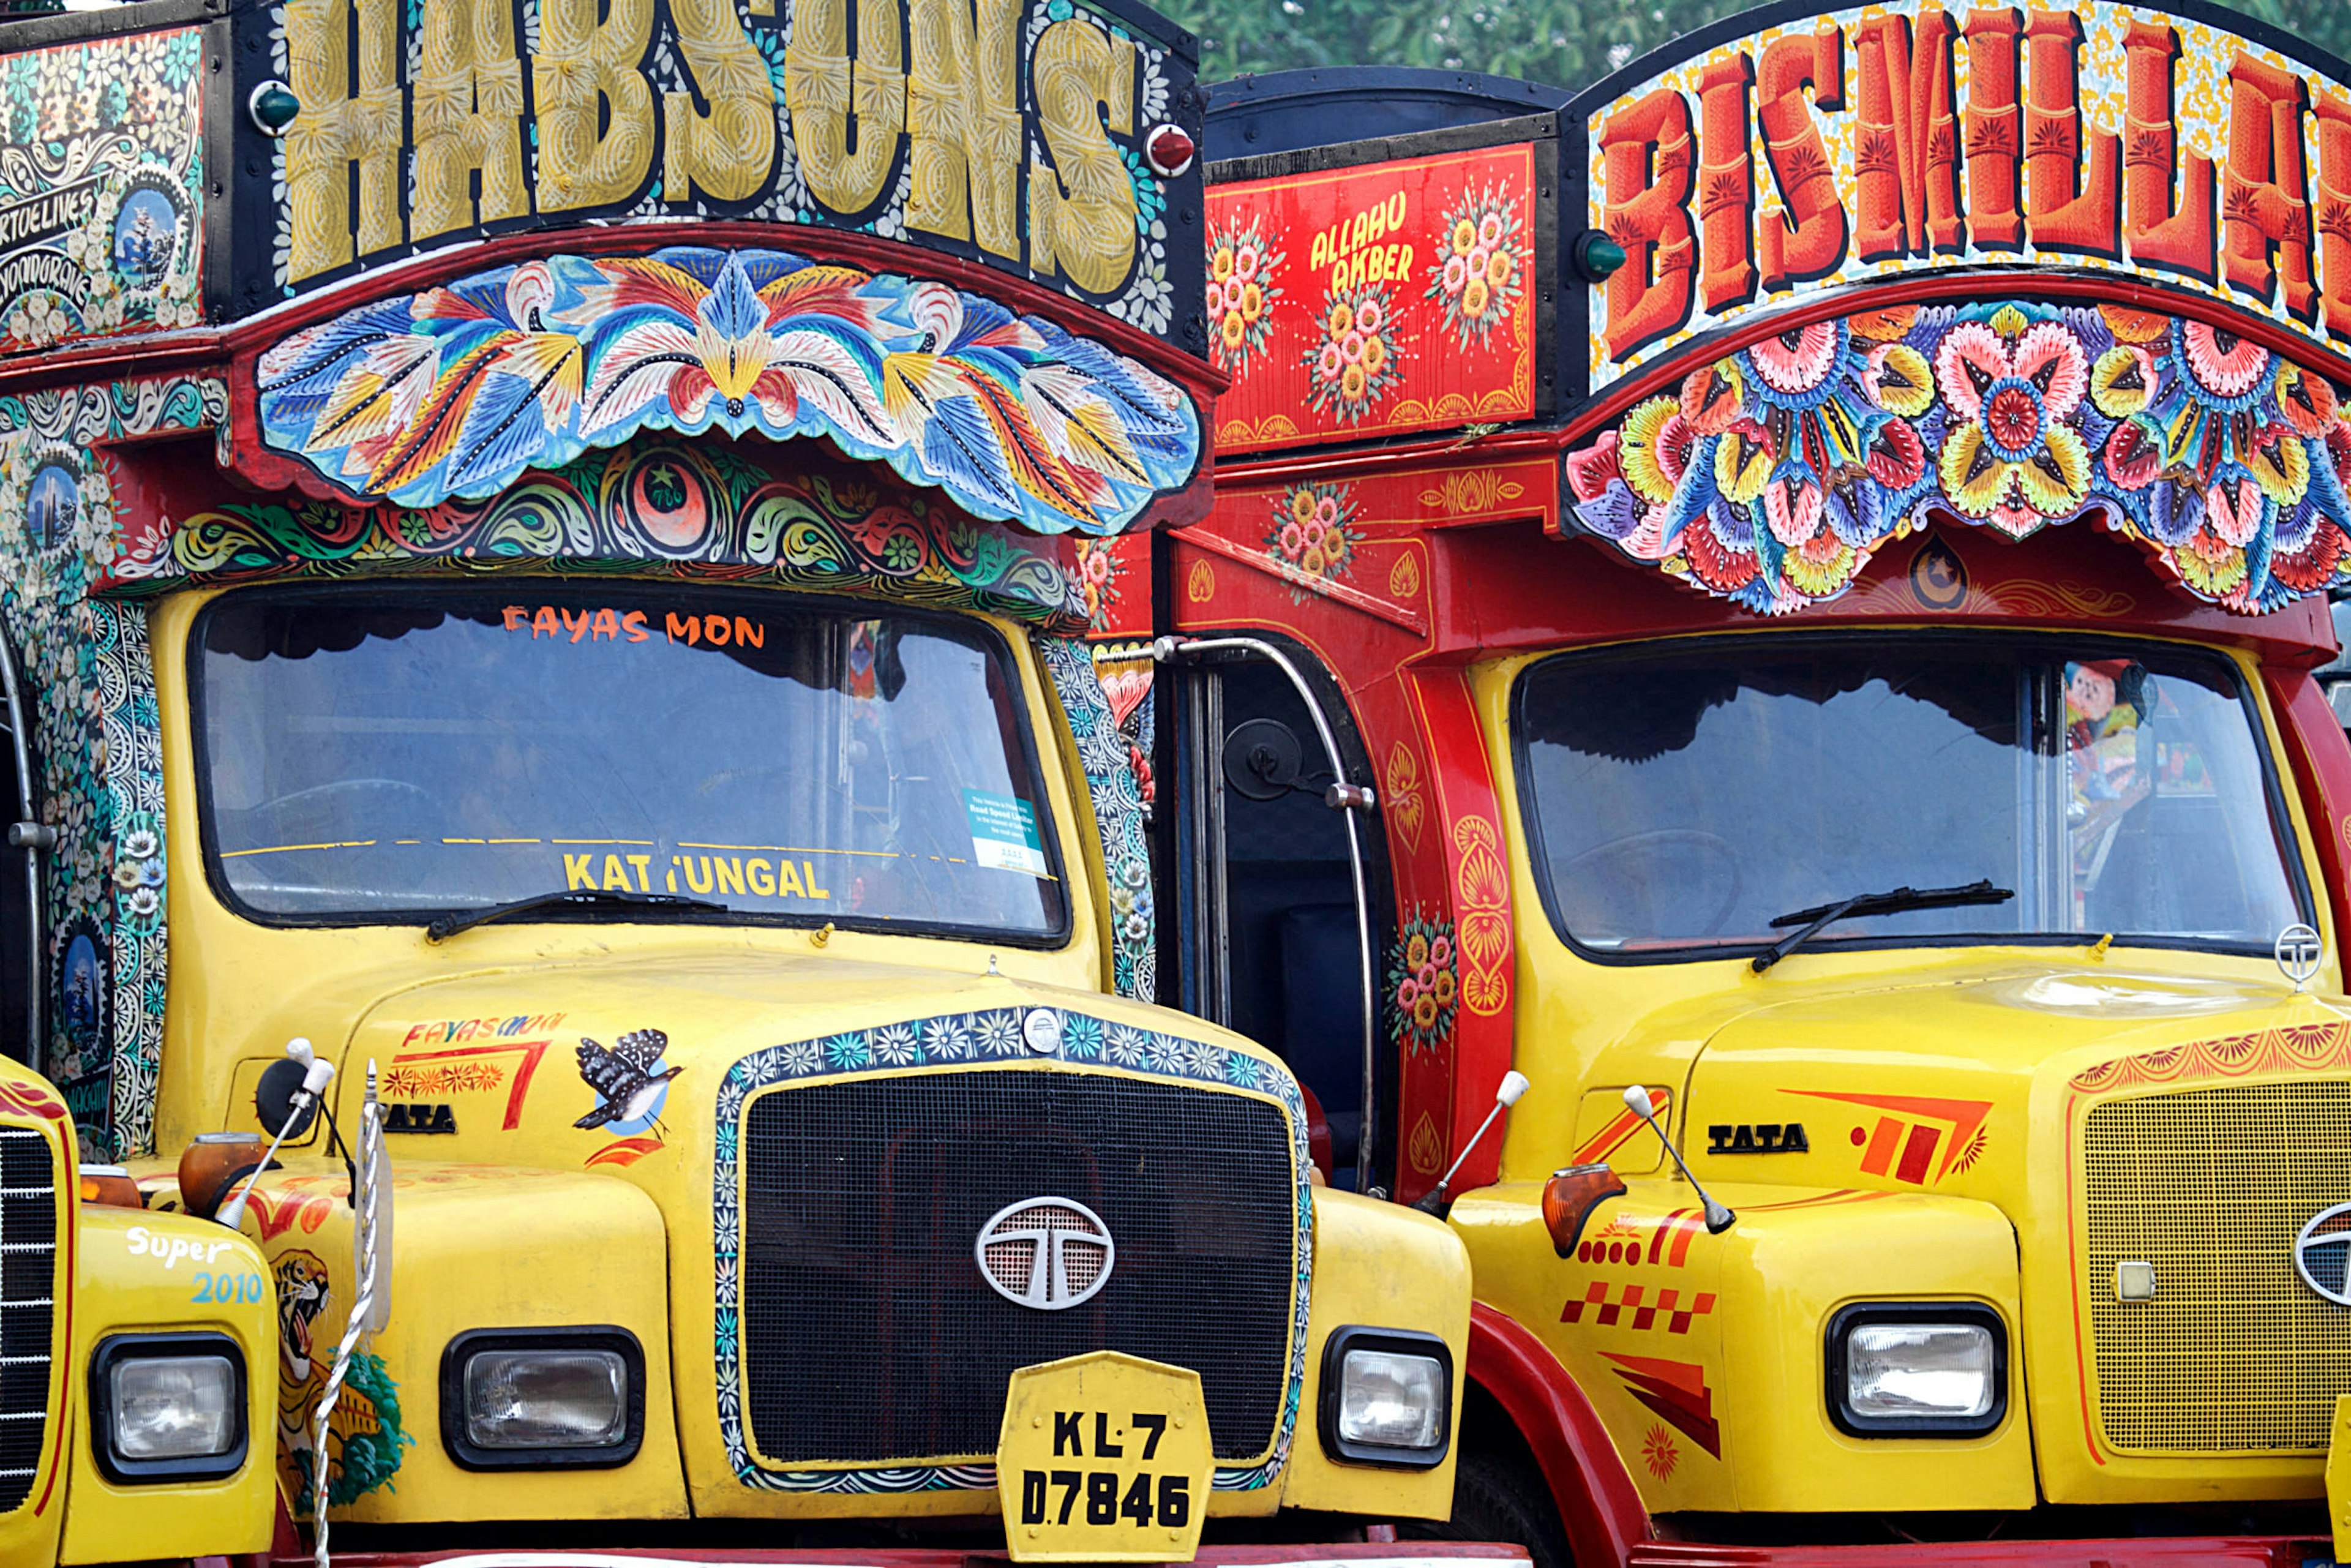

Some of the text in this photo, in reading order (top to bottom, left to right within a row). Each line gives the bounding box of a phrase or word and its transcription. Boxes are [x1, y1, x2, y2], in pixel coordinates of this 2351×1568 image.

[1310, 190, 1406, 271] ALLAHU
[1332, 244, 1414, 299] AKBER
[501, 606, 765, 648] FAYAS MON
[379, 1103, 456, 1133] ATA
[1708, 1123, 1809, 1155] TATA
[126, 1226, 232, 1270] Super
[190, 1272, 263, 1304] 2010
[1021, 1470, 1190, 1528] D.7846
